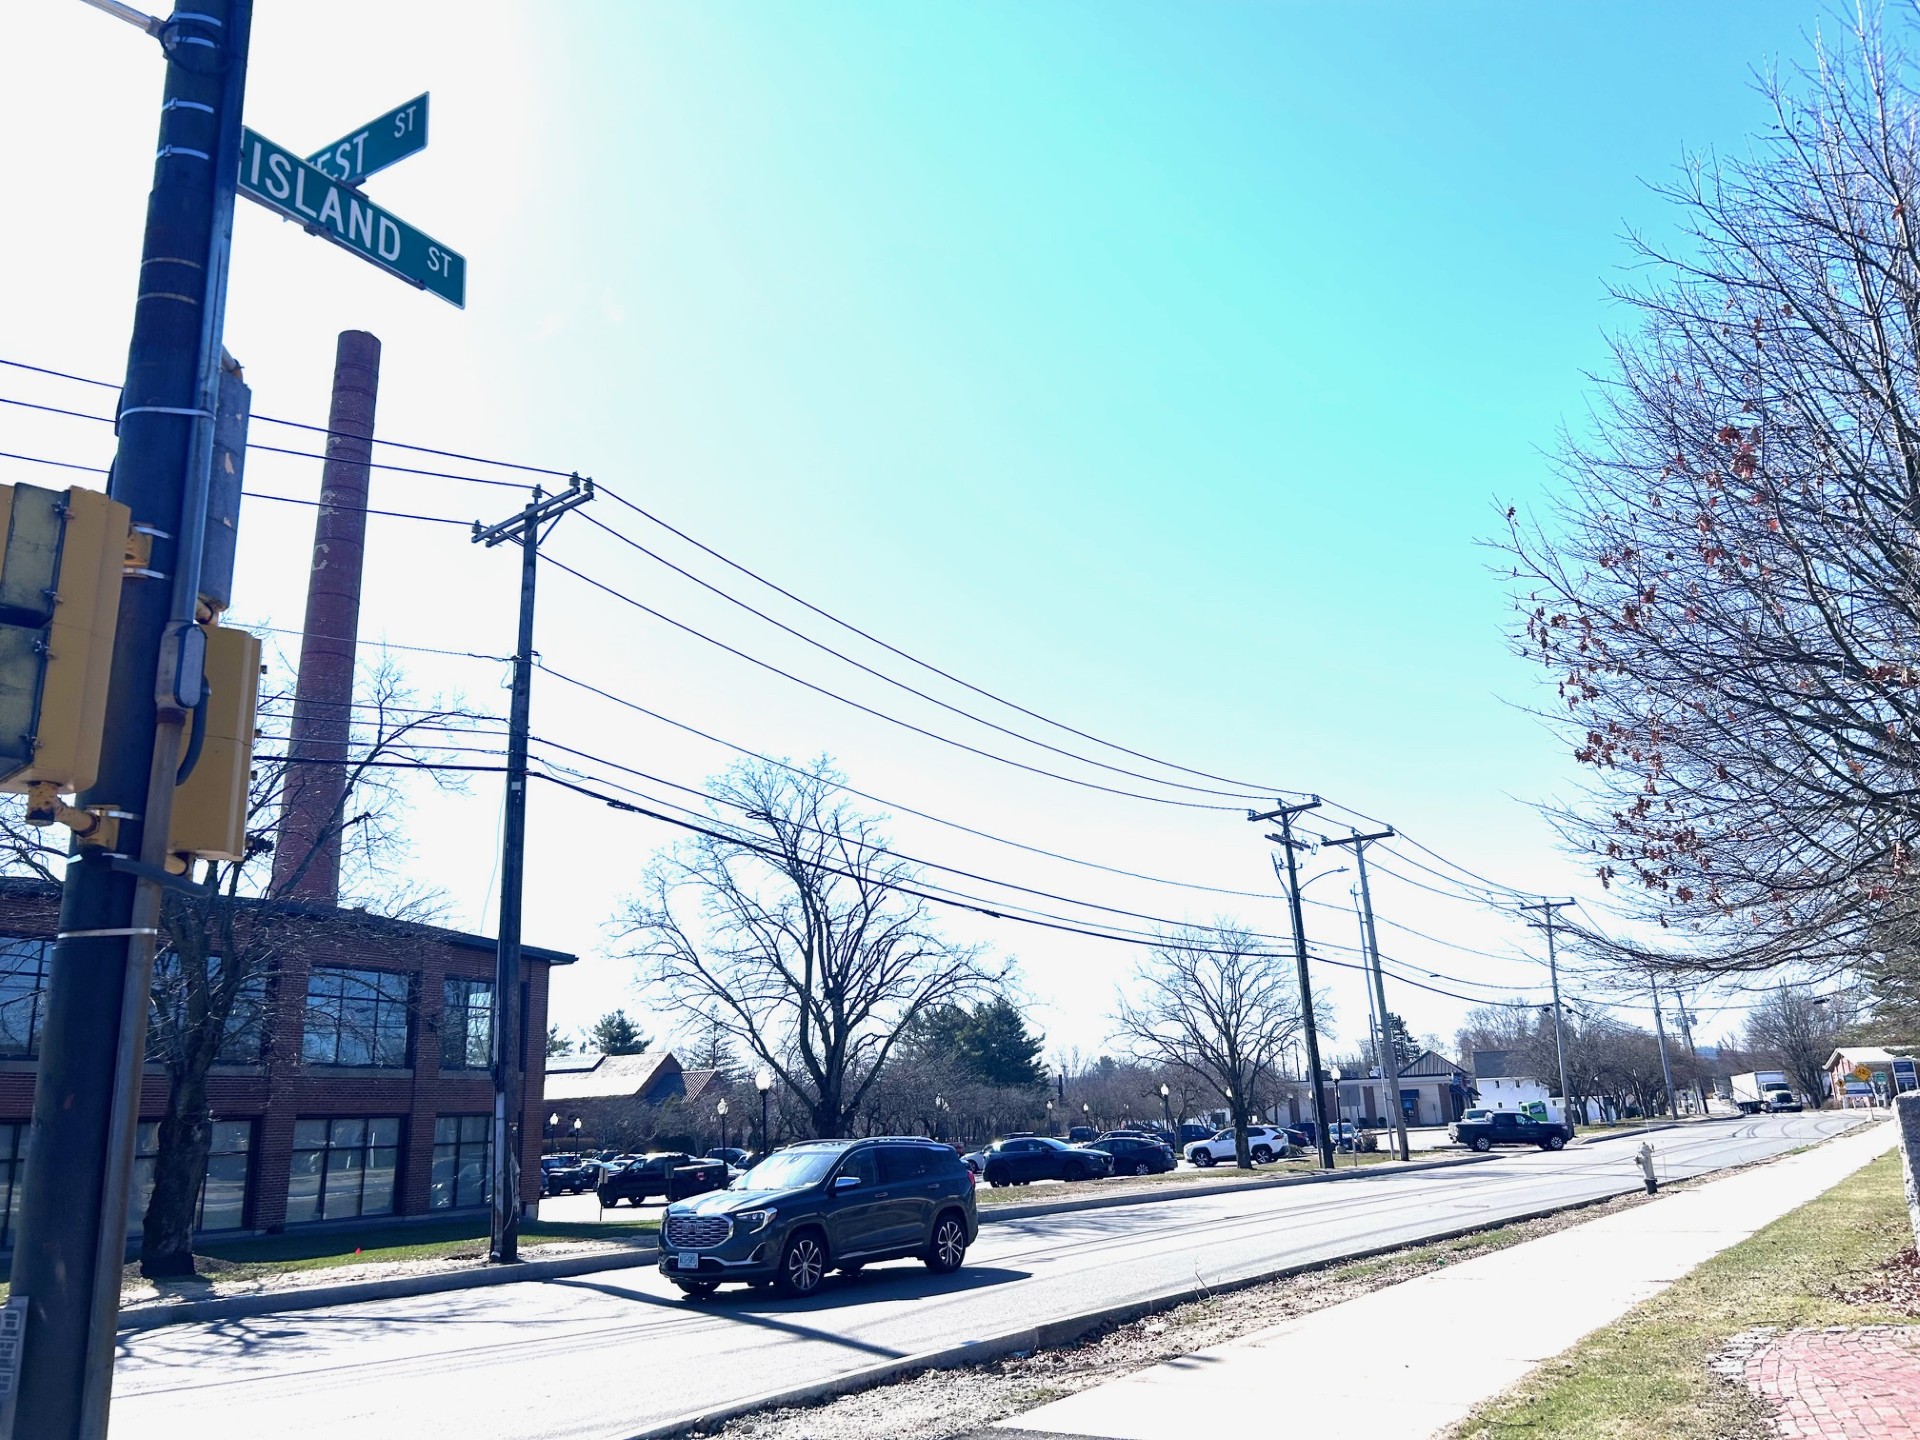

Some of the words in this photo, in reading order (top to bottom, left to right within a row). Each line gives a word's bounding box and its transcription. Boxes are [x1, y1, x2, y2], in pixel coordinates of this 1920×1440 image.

[394, 106, 417, 138] ST
[250, 141, 402, 262] ISLAND
[427, 246, 453, 277] ST
